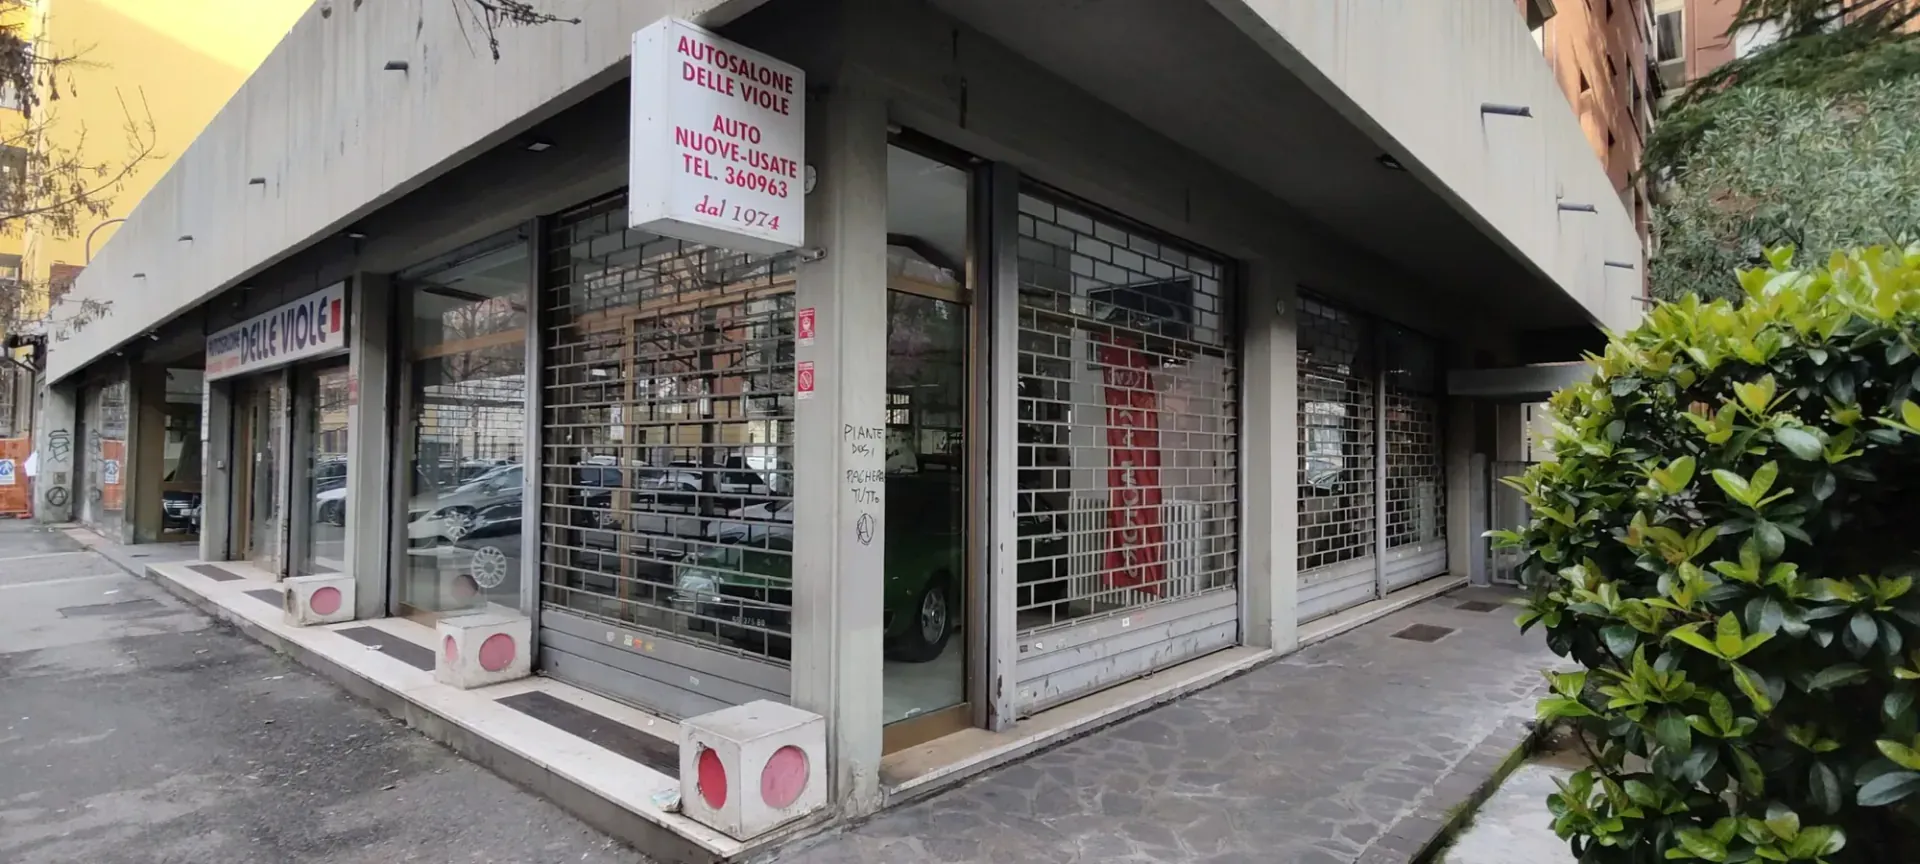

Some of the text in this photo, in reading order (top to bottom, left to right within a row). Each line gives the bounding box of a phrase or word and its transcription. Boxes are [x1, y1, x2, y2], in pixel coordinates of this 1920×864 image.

[678, 36, 793, 94] AUTOSALONE
[683, 62, 789, 116] DELLE VIOLE
[676, 127, 797, 179] NUOVE-USATE
[713, 115, 761, 144] AUTO
[683, 154, 788, 198] TEL. 360963
[695, 195, 780, 231] dal 1974
[241, 316, 276, 365] DELLE
[281, 296, 327, 354] VIOLE
[844, 424, 884, 442] PIANTE
